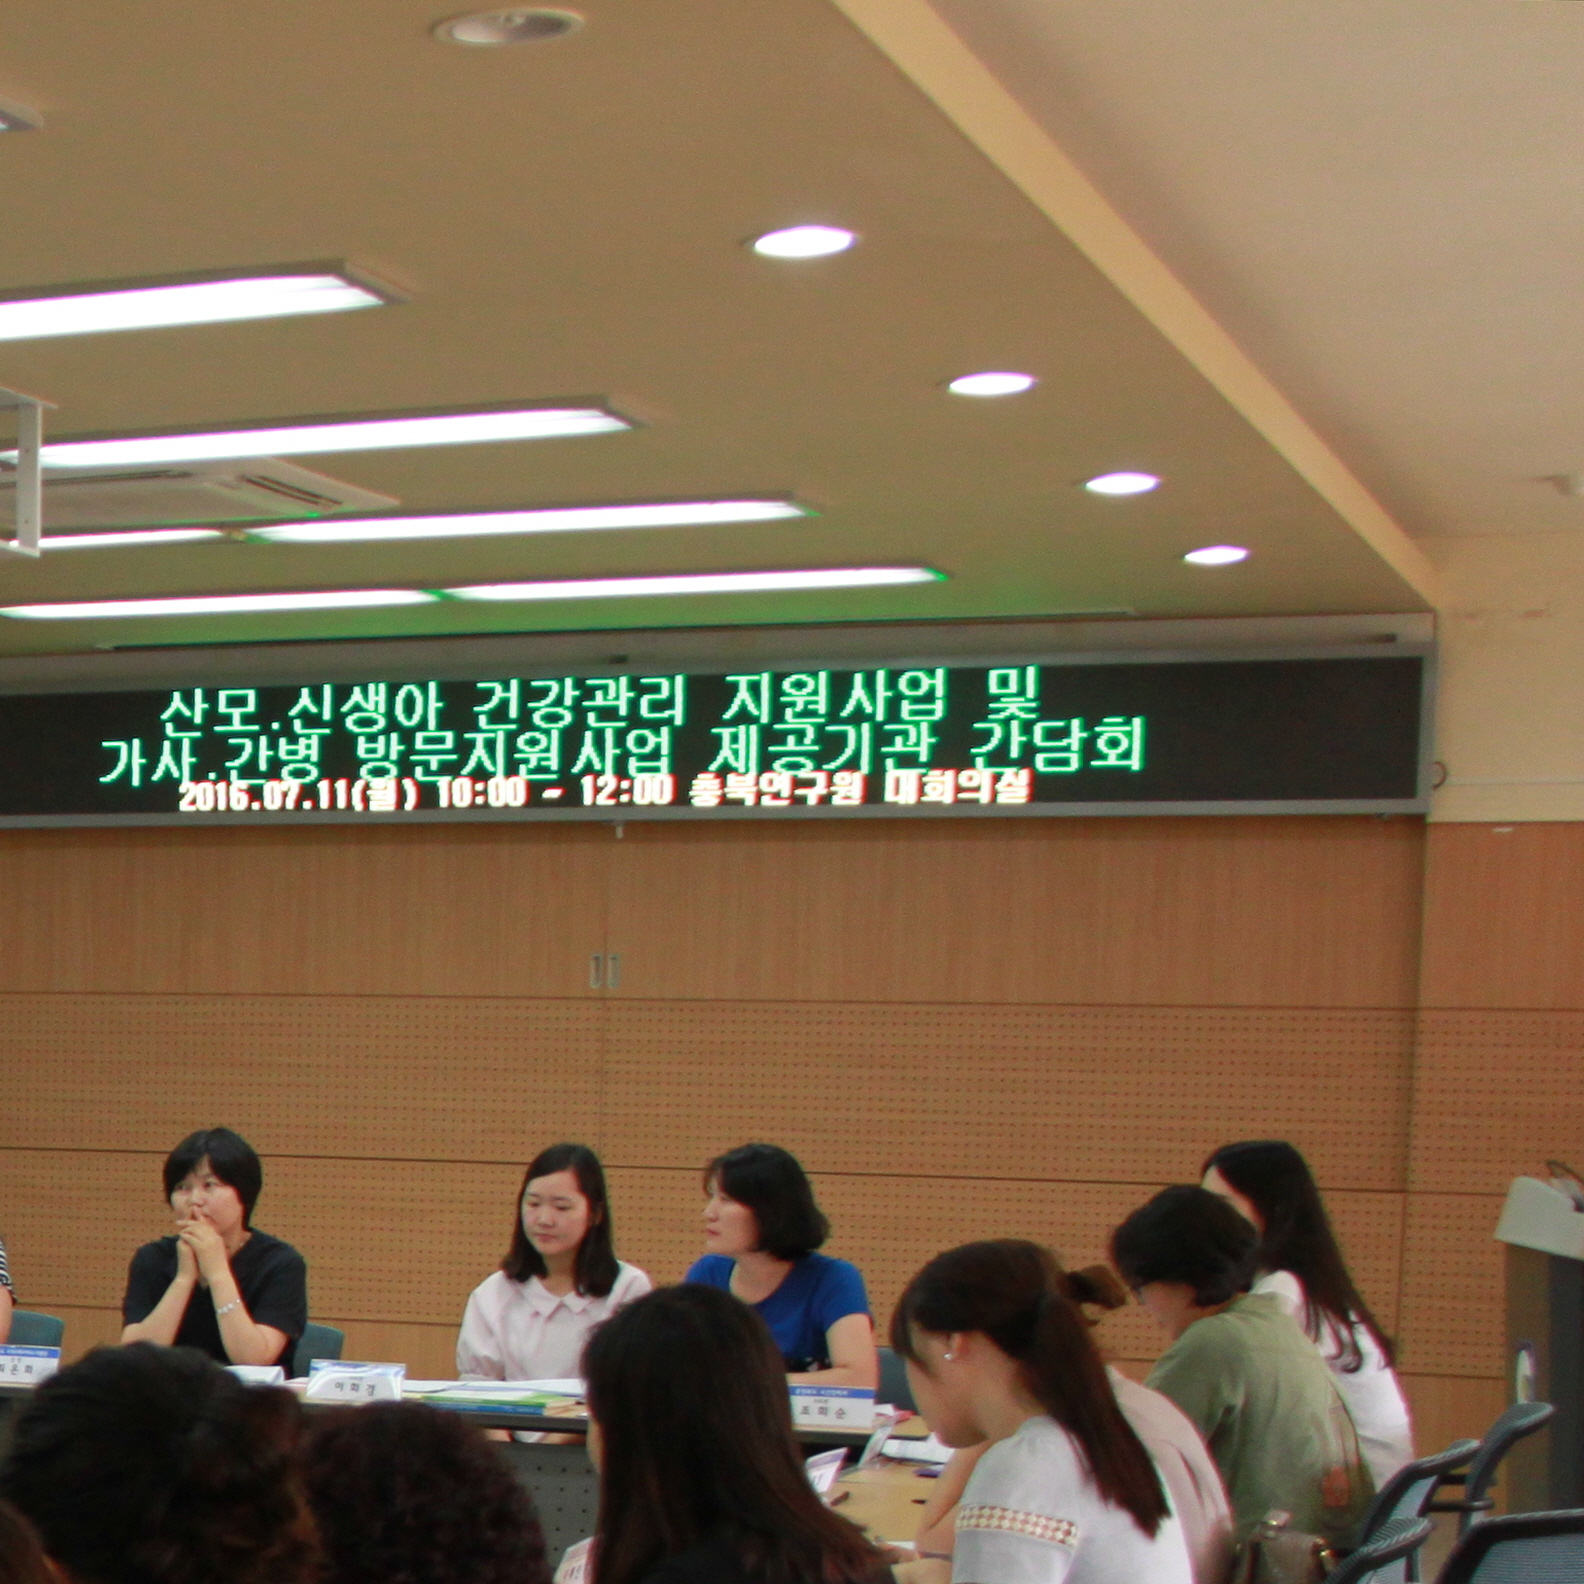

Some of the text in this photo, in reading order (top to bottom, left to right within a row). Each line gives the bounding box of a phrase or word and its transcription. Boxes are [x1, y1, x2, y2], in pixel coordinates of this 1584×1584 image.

[160, 664, 1040, 738] 산모.신생아 건강관리 지원사업 및
[98, 716, 1146, 787] 가사.간병 방문지원사업 제공기관 간담회
[436, 775, 530, 808] 10:00
[582, 773, 677, 807] 12:00
[688, 770, 868, 808] 충북연구원
